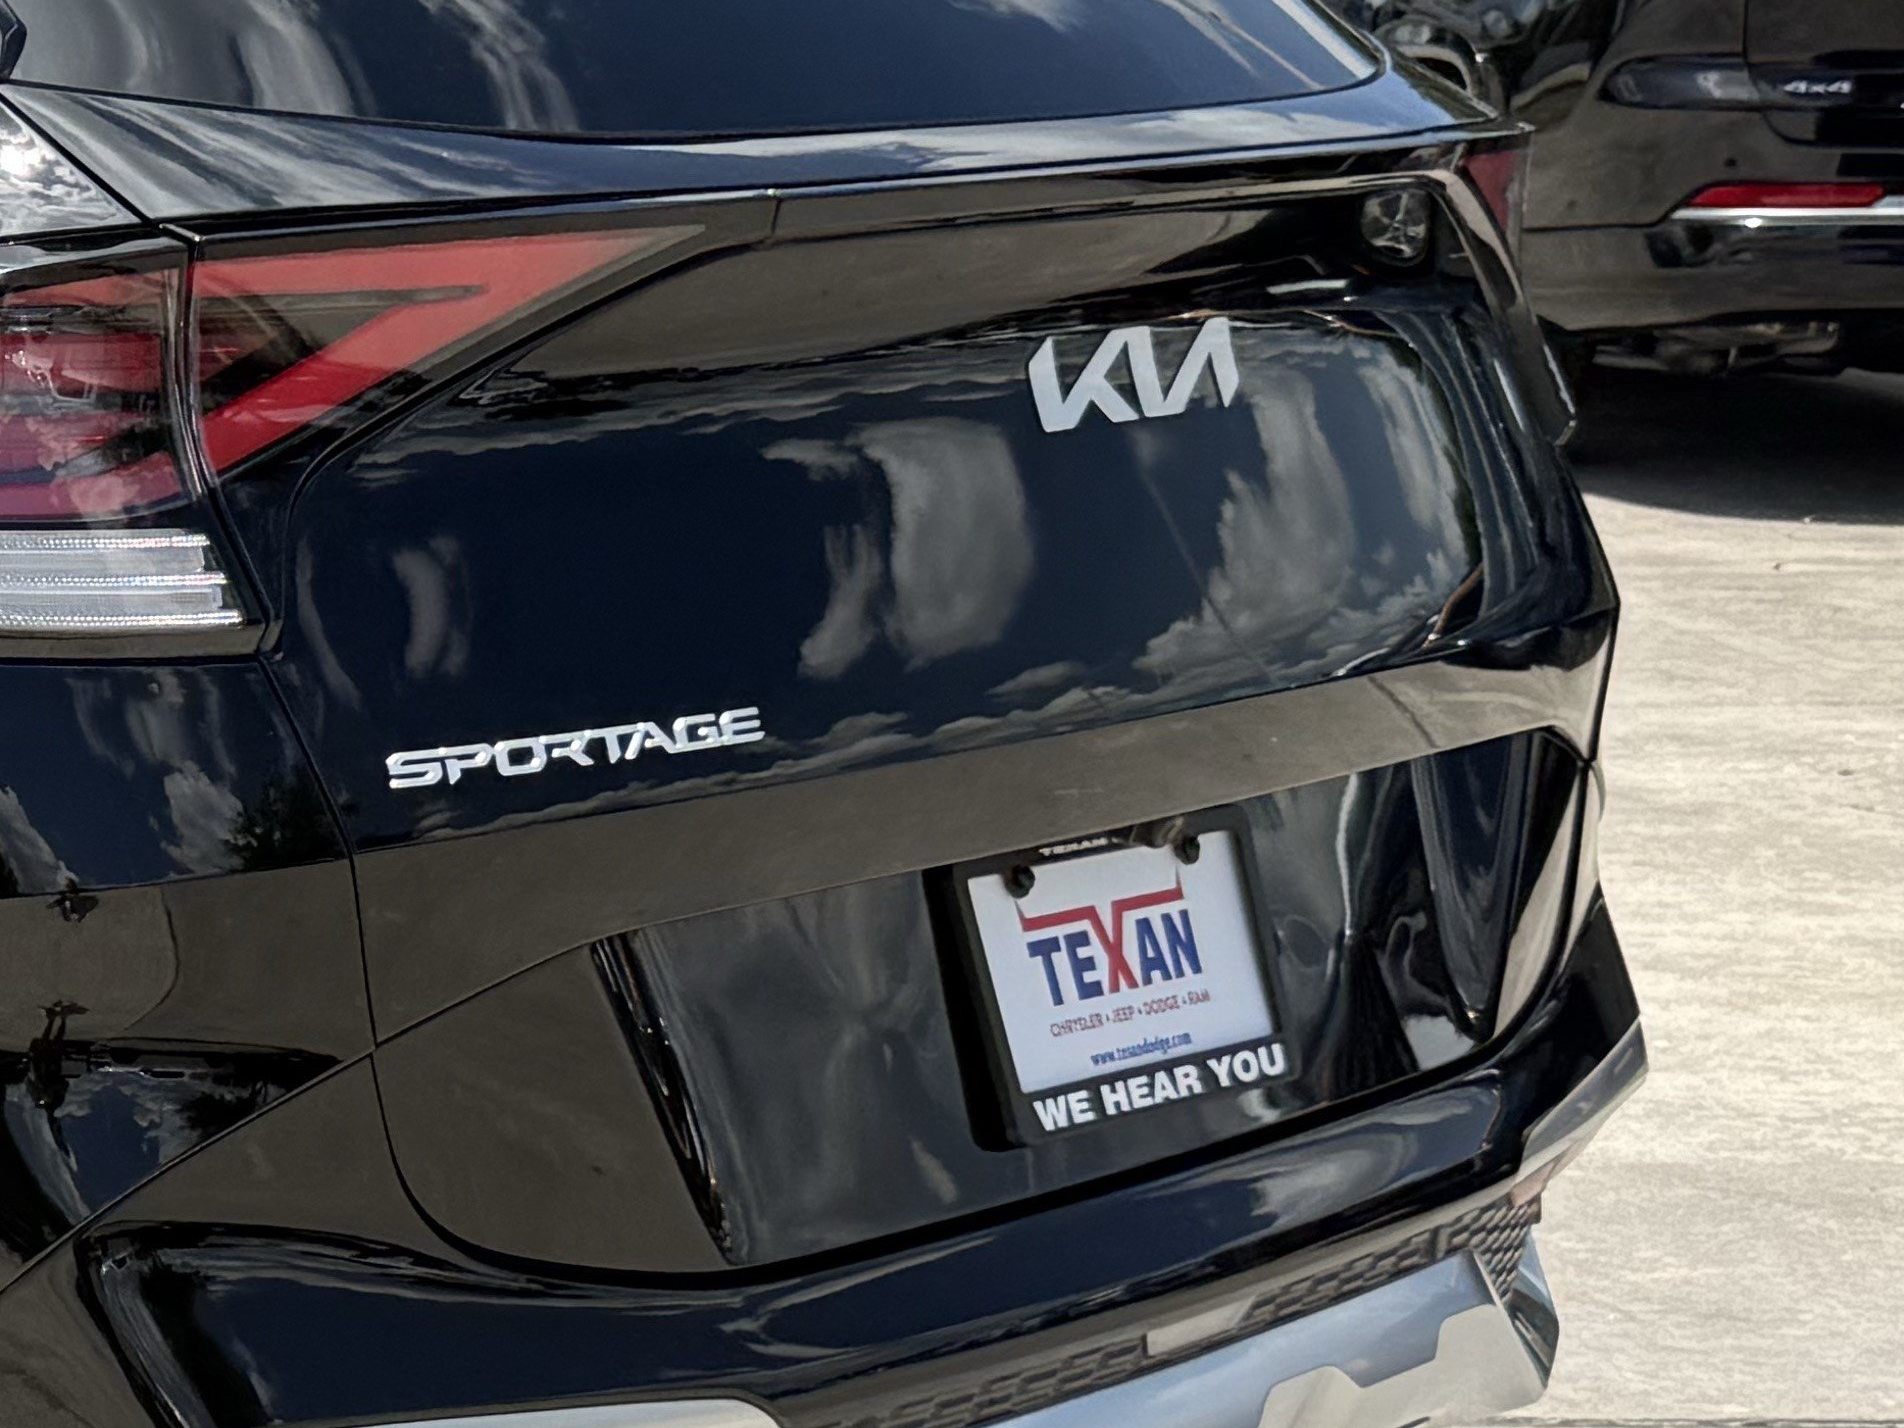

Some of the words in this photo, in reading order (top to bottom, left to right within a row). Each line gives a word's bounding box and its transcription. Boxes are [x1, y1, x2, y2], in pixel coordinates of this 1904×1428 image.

[1027, 315, 1240, 432] KIA
[385, 706, 766, 789] SPORTAGE
[1025, 900, 1204, 1006] TEXAN
[1033, 1089, 1097, 1132] WE
[1099, 1064, 1206, 1115] HEAR
[1206, 1042, 1287, 1088] YOU
